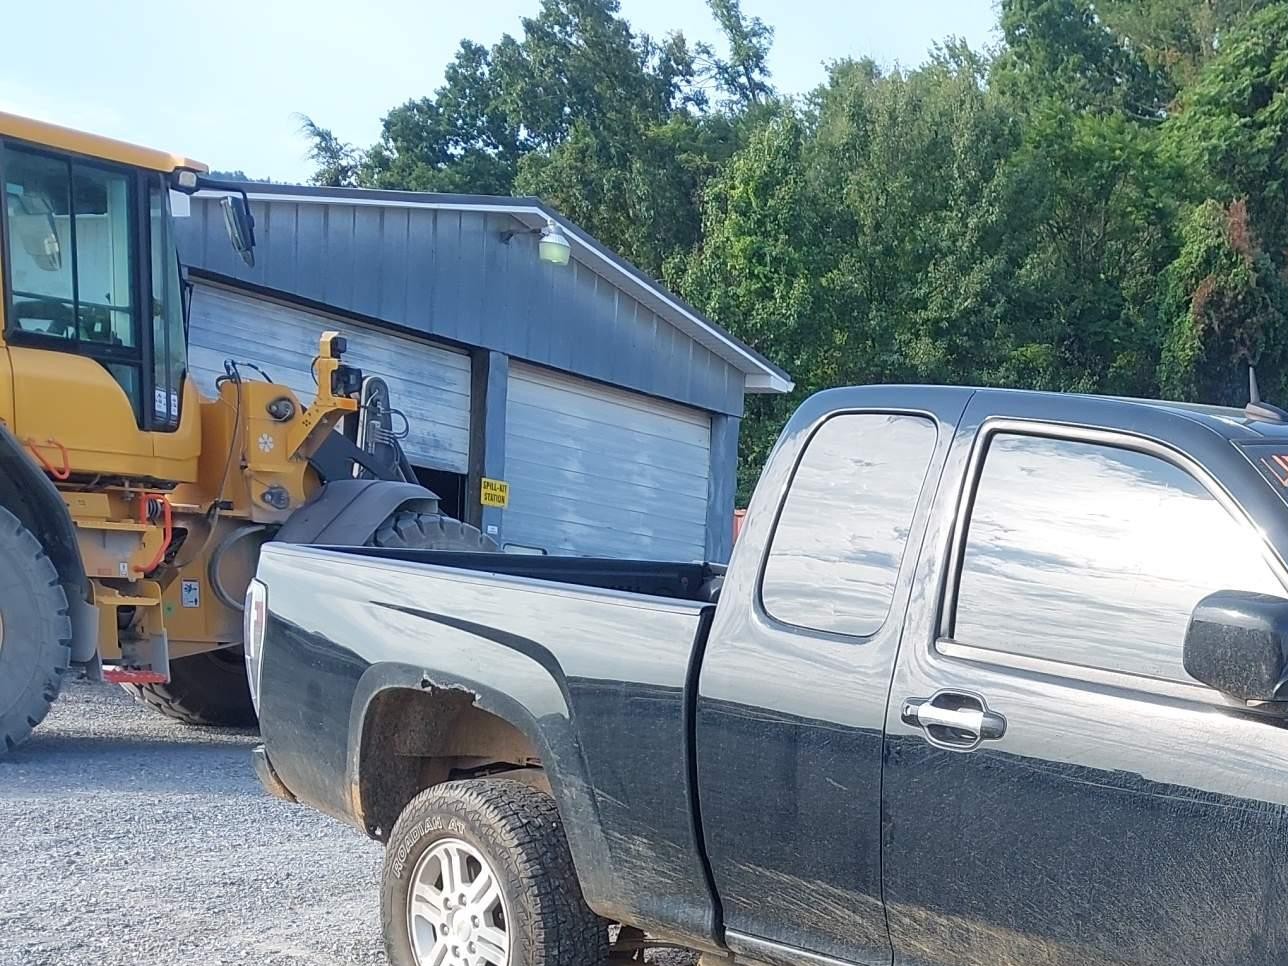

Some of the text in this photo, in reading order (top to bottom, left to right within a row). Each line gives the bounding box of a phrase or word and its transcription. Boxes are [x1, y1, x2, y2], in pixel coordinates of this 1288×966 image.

[483, 480, 507, 493] SPILL-KIT
[484, 492, 505, 504] STATION
[392, 816, 466, 879] ROADIAN AT
